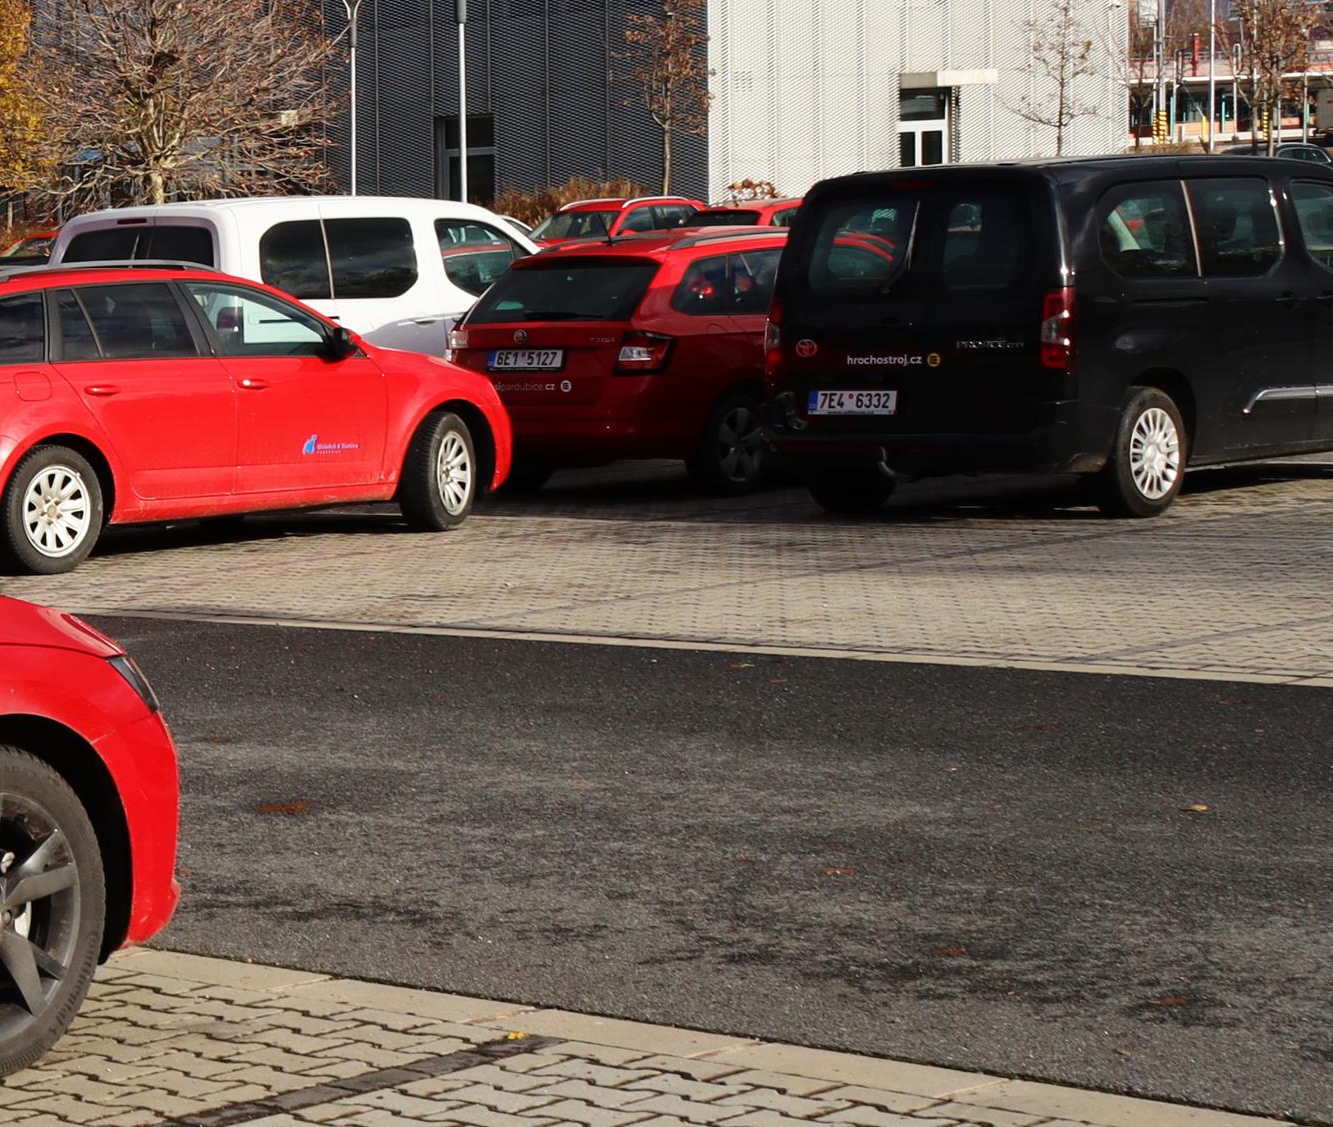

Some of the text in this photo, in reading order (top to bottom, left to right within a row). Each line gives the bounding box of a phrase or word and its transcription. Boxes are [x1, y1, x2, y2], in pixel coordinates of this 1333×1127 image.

[496, 351, 558, 366] 6E1 5127
[846, 354, 923, 366] hrochostroj.cz
[819, 392, 891, 409] 7E4 6332
